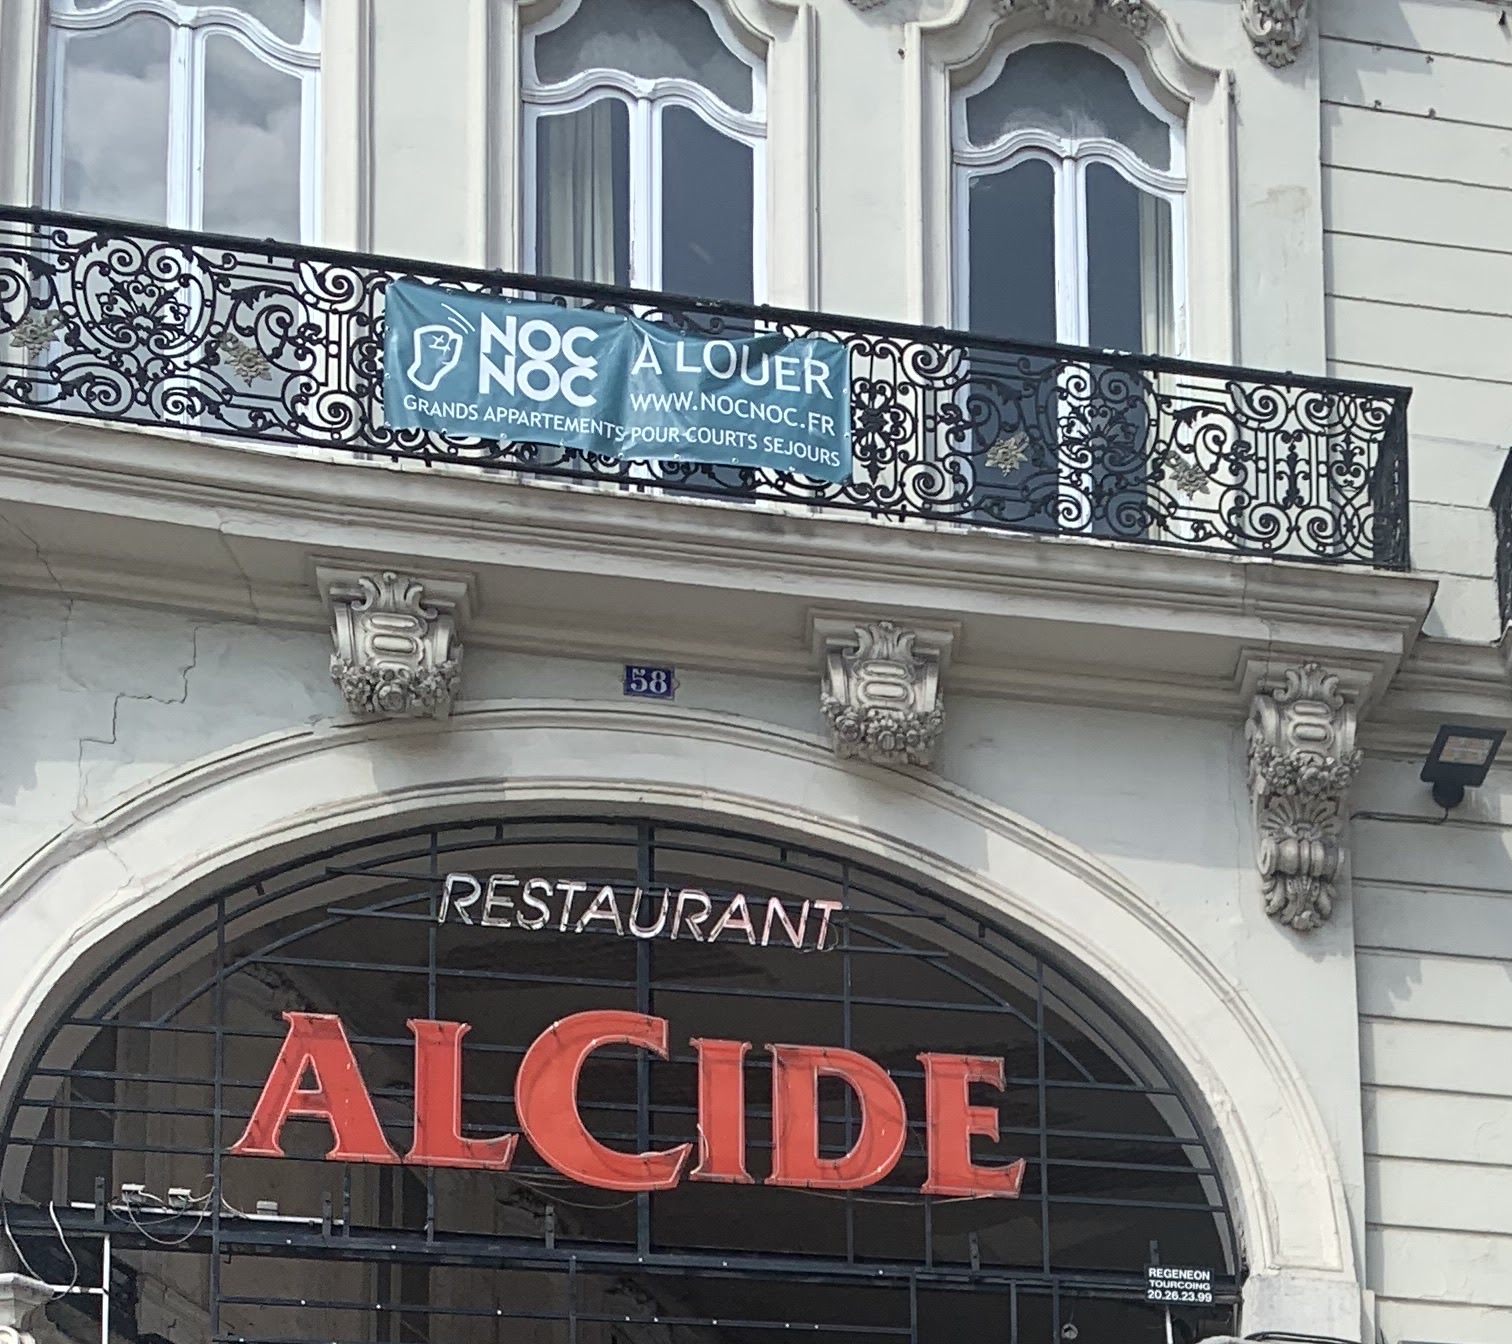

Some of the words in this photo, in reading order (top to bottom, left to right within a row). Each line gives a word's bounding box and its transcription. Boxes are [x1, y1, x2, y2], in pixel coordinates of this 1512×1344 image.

[480, 312, 600, 368] NOC
[631, 333, 663, 375] A
[676, 340, 834, 399] LOUER
[478, 352, 598, 407] NOC
[403, 394, 479, 421] GRANDS
[483, 407, 625, 442] APPARTEMENTS
[631, 426, 680, 443] POUR
[685, 427, 758, 450] COURTS
[763, 436, 841, 467] SEJOURS
[630, 391, 836, 437] WWW.NOCNOC.FR
[630, 668, 668, 694] 58
[437, 872, 844, 951] RESTAURANT
[229, 1009, 1027, 1198] ALCIDE
[1147, 1289, 1213, 1303] 20.26.23.99
[1148, 1267, 1211, 1281] REGENEON
[1148, 1280, 1211, 1291] TOURCOING
